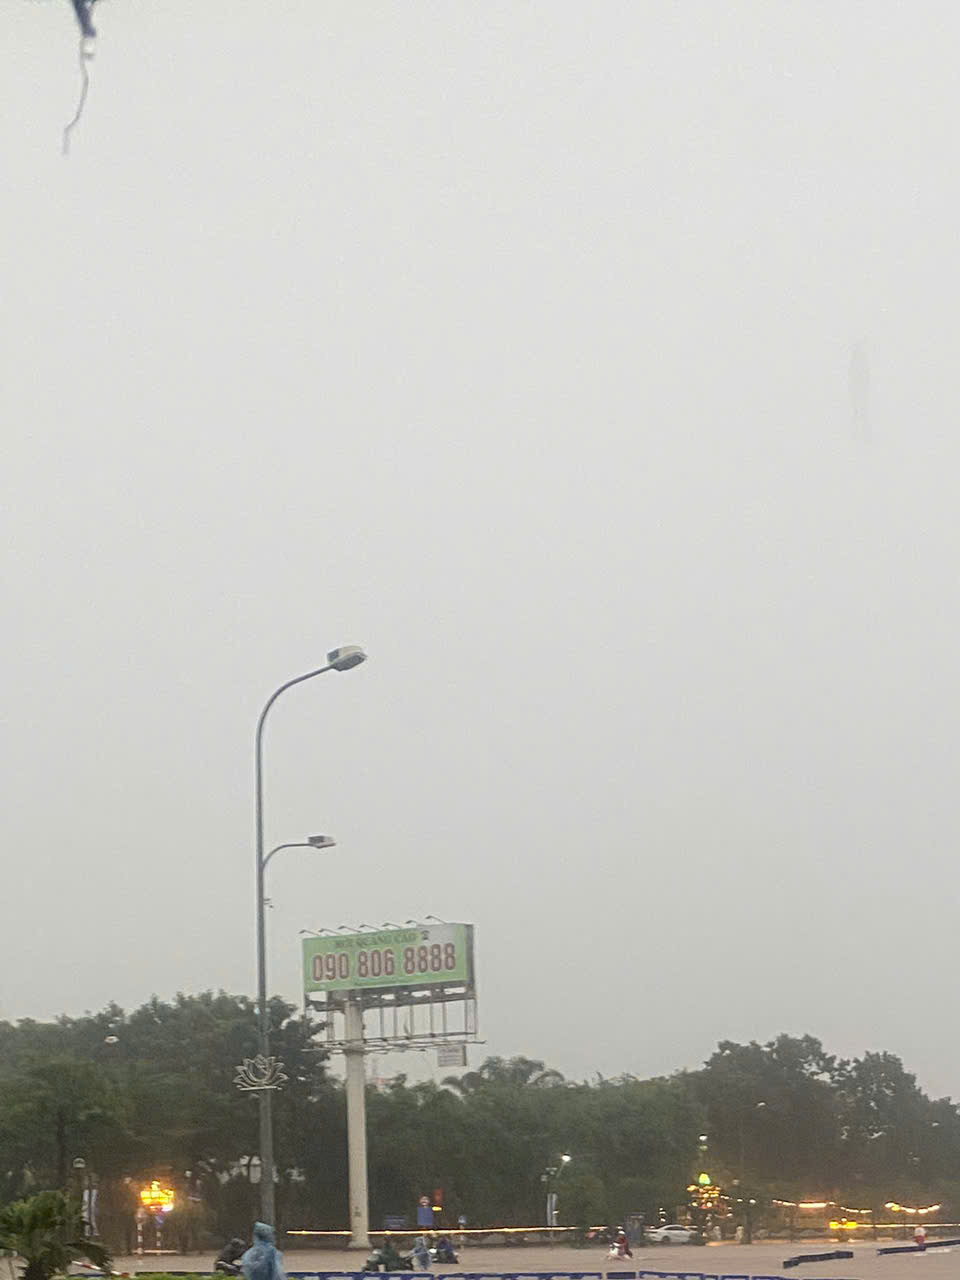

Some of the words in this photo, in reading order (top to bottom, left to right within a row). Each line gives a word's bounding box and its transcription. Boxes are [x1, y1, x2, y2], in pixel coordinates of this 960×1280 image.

[312, 952, 350, 981] 090
[358, 948, 395, 977] 806
[404, 943, 456, 974] 8888
